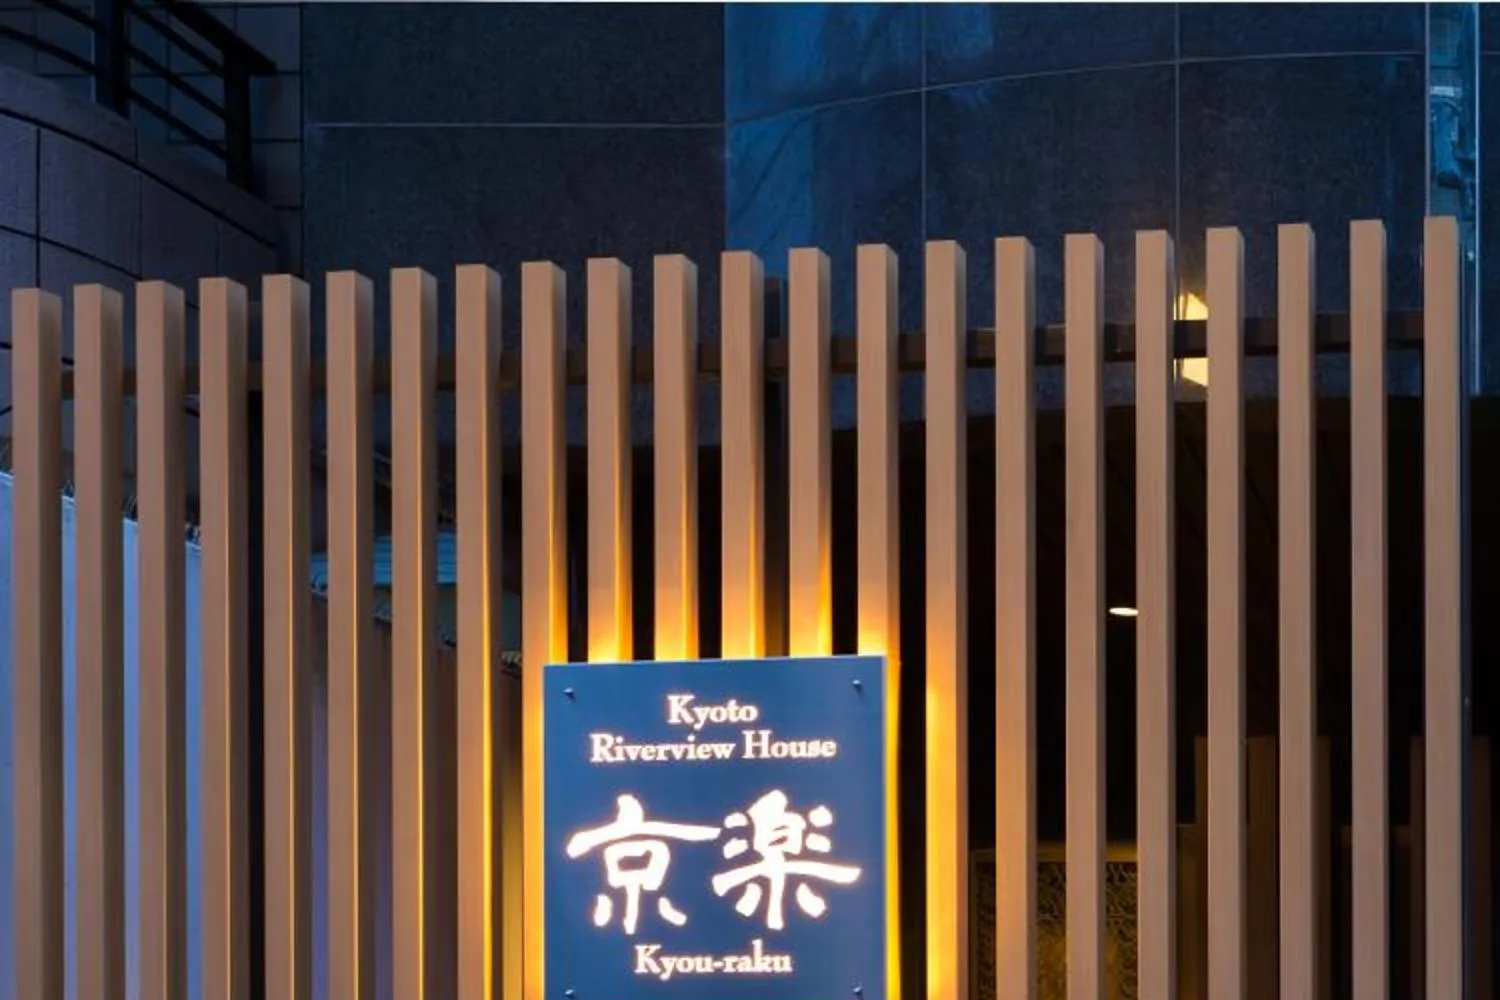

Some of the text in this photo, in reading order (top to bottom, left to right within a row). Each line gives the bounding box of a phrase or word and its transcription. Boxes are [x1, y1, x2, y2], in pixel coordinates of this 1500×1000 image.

[667, 694, 758, 729] Kyoto
[590, 730, 837, 763] Riverview House
[566, 789, 862, 935] 京楽
[634, 939, 793, 981] Kyou-raku
